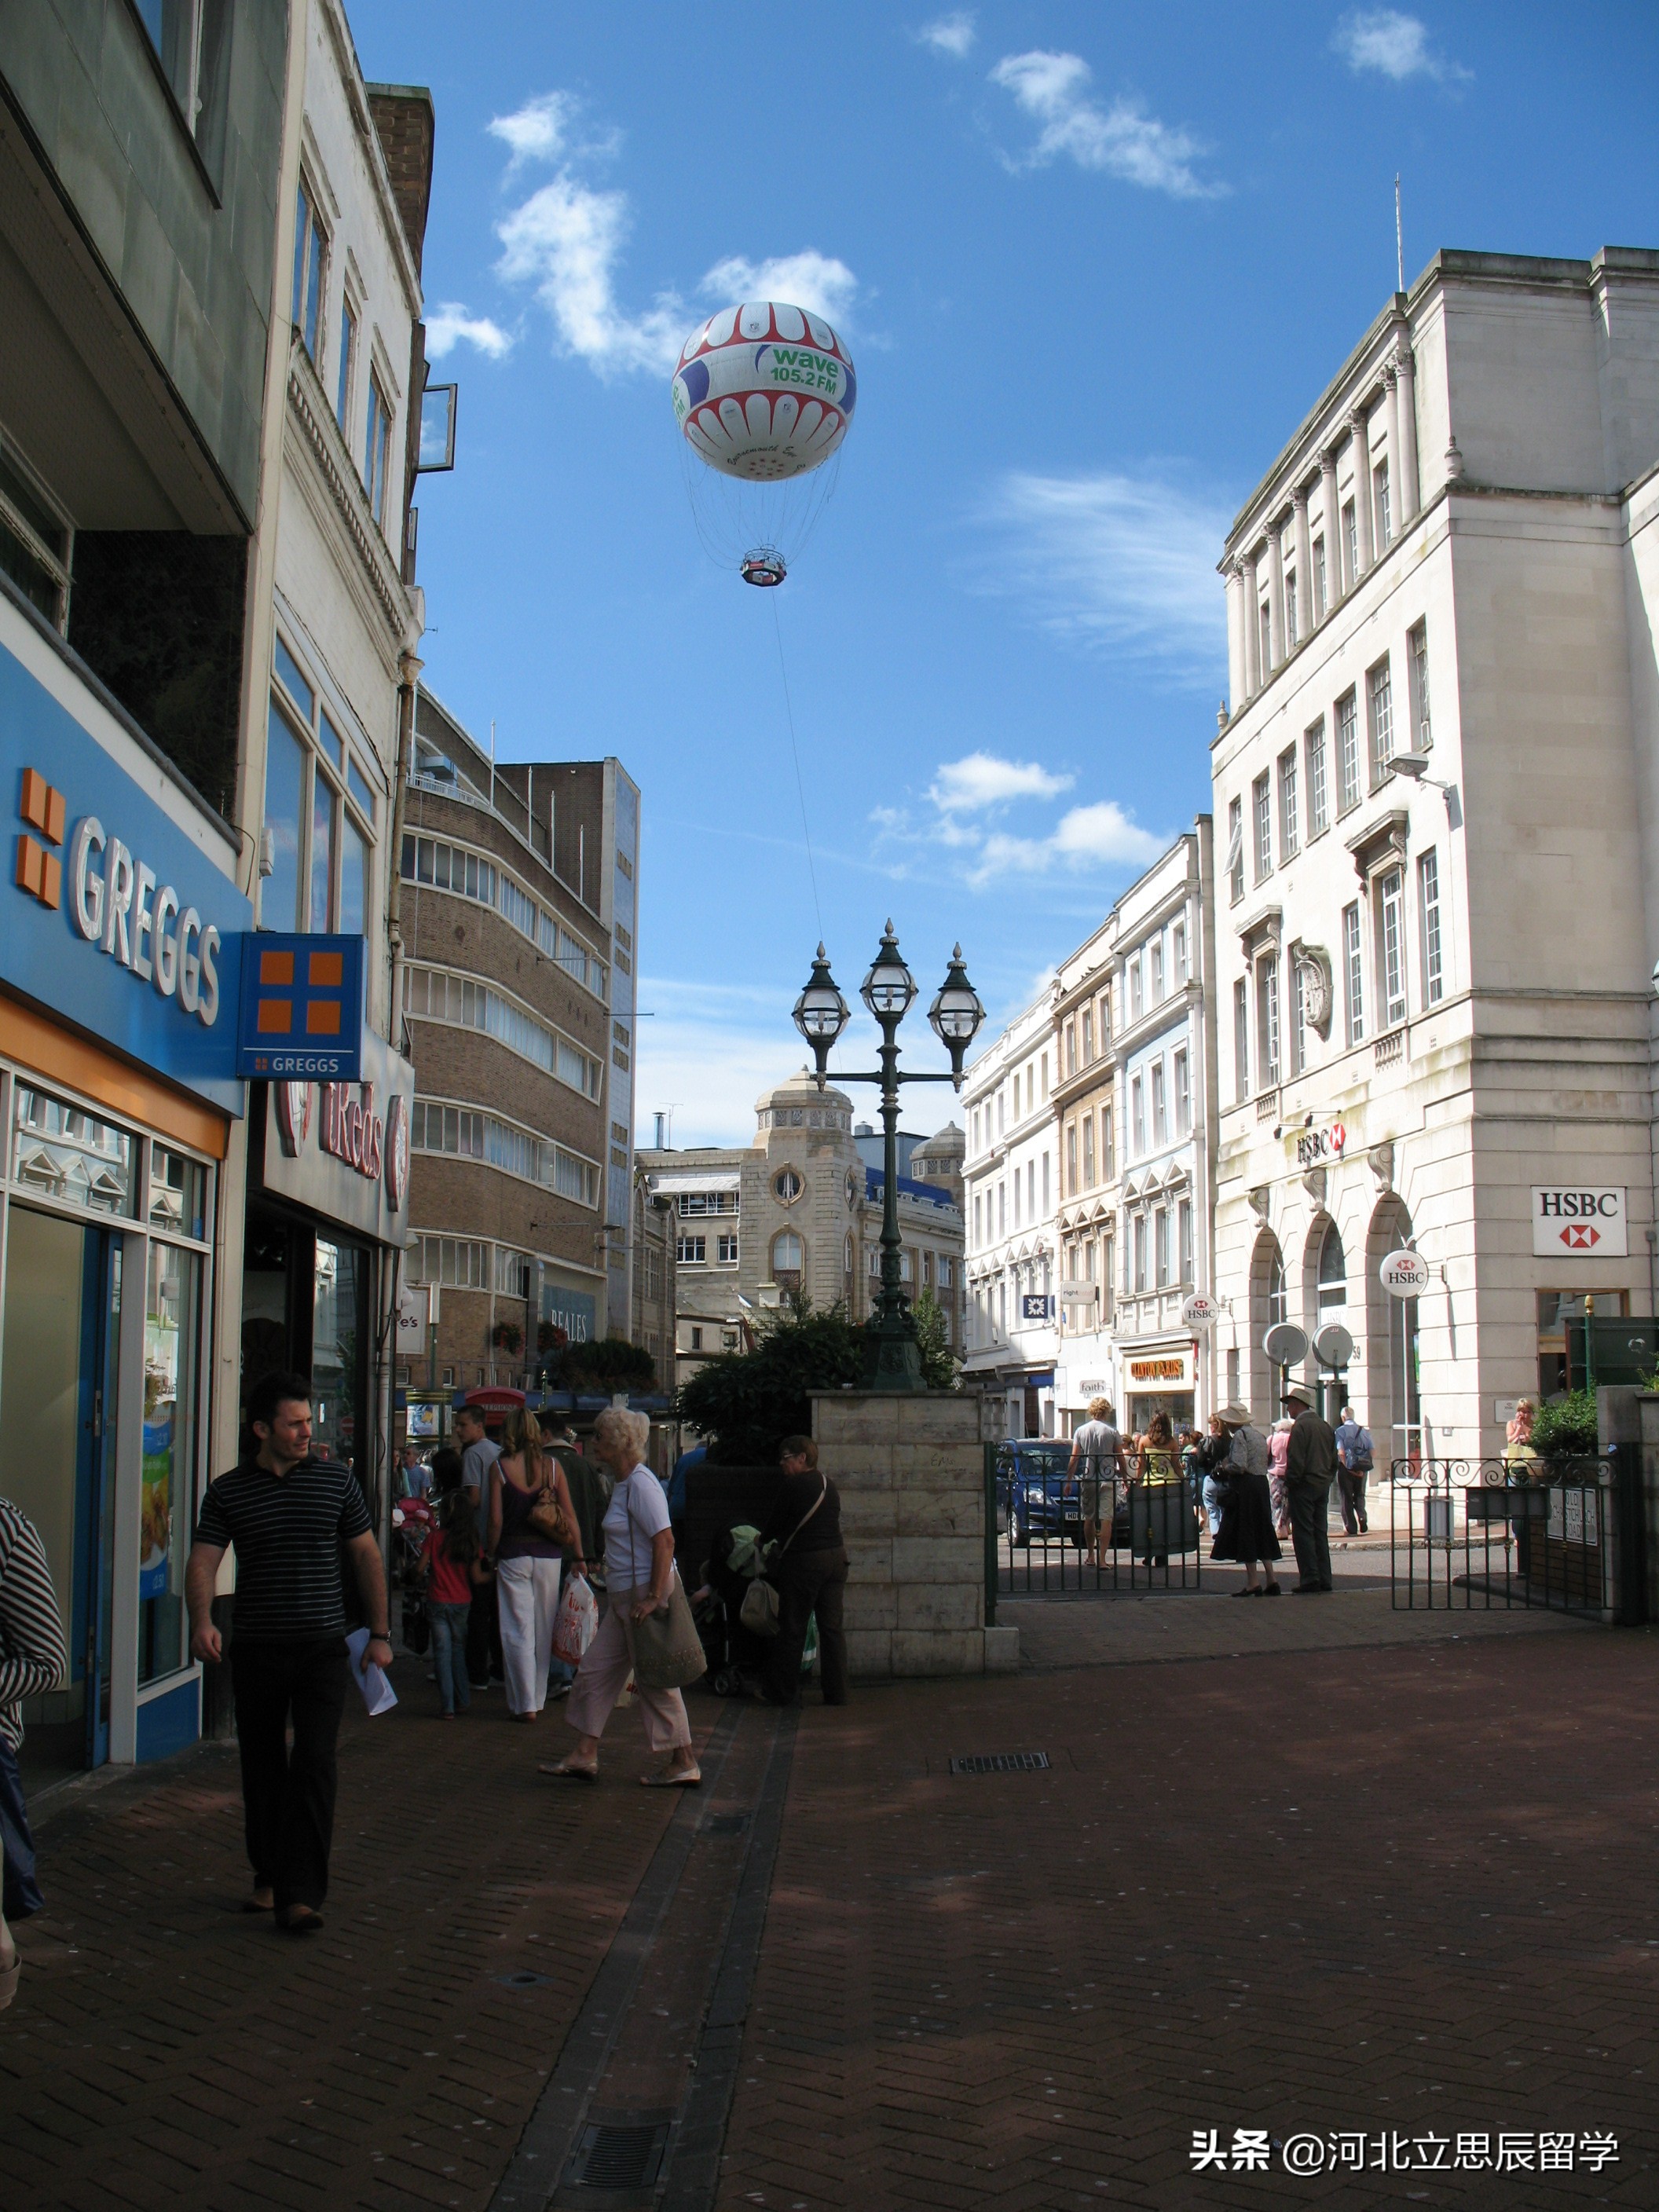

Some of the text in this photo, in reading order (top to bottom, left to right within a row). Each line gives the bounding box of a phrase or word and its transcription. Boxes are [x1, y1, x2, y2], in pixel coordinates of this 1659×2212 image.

[773, 349, 839, 378] wave
[771, 368, 837, 394] 105.2 FM
[69, 816, 221, 1026] GREGGS
[273, 1057, 339, 1072] GREGGS
[1298, 1129, 1328, 1163] HSBC
[1540, 1192, 1618, 1217] HSBC
[1388, 1272, 1424, 1284] HSBC
[401, 1316, 418, 1328] e's
[1188, 1309, 1215, 1319] HSBC
[1082, 1382, 1104, 1392] faith
[1552, 1505, 1595, 1524] CHRSTCHUCH
